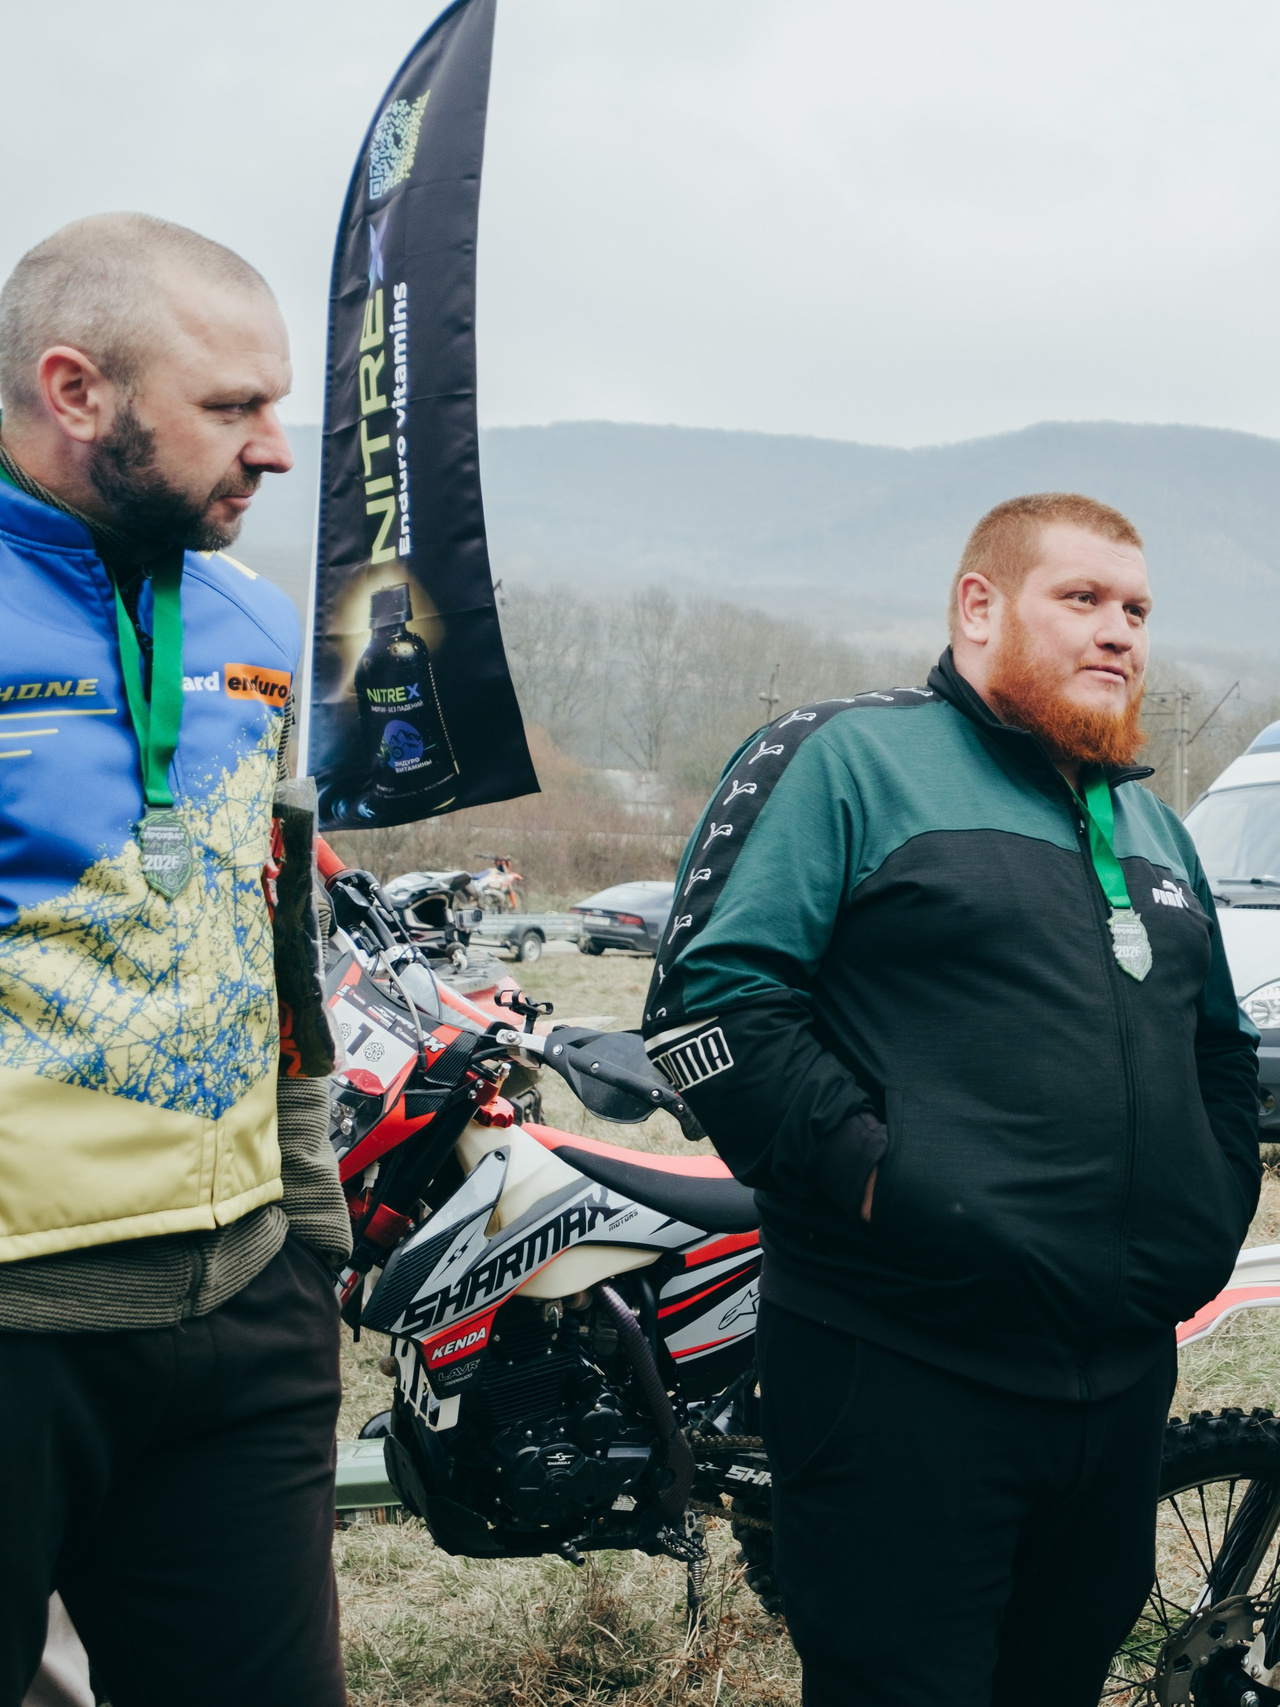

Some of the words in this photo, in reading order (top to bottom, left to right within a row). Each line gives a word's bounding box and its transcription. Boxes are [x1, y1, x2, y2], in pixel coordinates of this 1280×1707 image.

[388, 281, 409, 429] vitamins
[358, 211, 397, 565] NITREX
[395, 434, 412, 556] Enduro
[182, 671, 220, 692] ard
[227, 675, 289, 699] enduro
[366, 682, 421, 703] NITREX
[394, 756, 421, 767] ЭНДУРО
[395, 759, 433, 774] ВИТАМИНЫ
[346, 1021, 375, 1056] 1
[608, 1208, 640, 1233] MOTORS
[401, 1188, 636, 1335] SHARMAX
[426, 1326, 487, 1361] KENDA
[438, 1360, 480, 1382] LAVR
